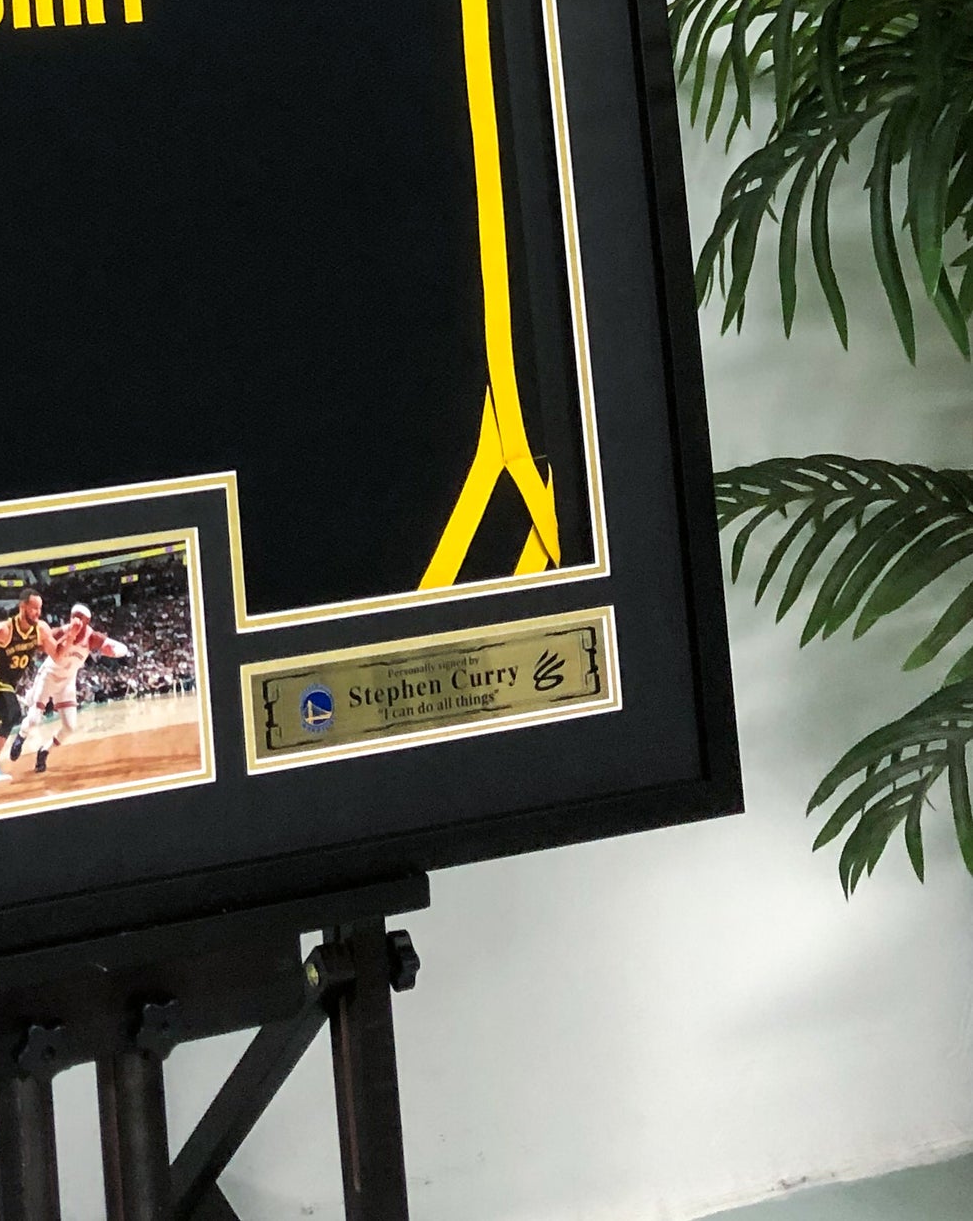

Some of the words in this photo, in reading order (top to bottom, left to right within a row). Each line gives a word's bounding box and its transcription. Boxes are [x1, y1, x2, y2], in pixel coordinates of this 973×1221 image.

[9, 654, 30, 669] 30
[438, 658, 467, 673] signed
[469, 655, 480, 666] by
[348, 678, 442, 708] Stephen
[451, 664, 519, 691] Curry
[391, 706, 414, 718] can
[417, 701, 433, 714] do
[437, 697, 452, 711] all
